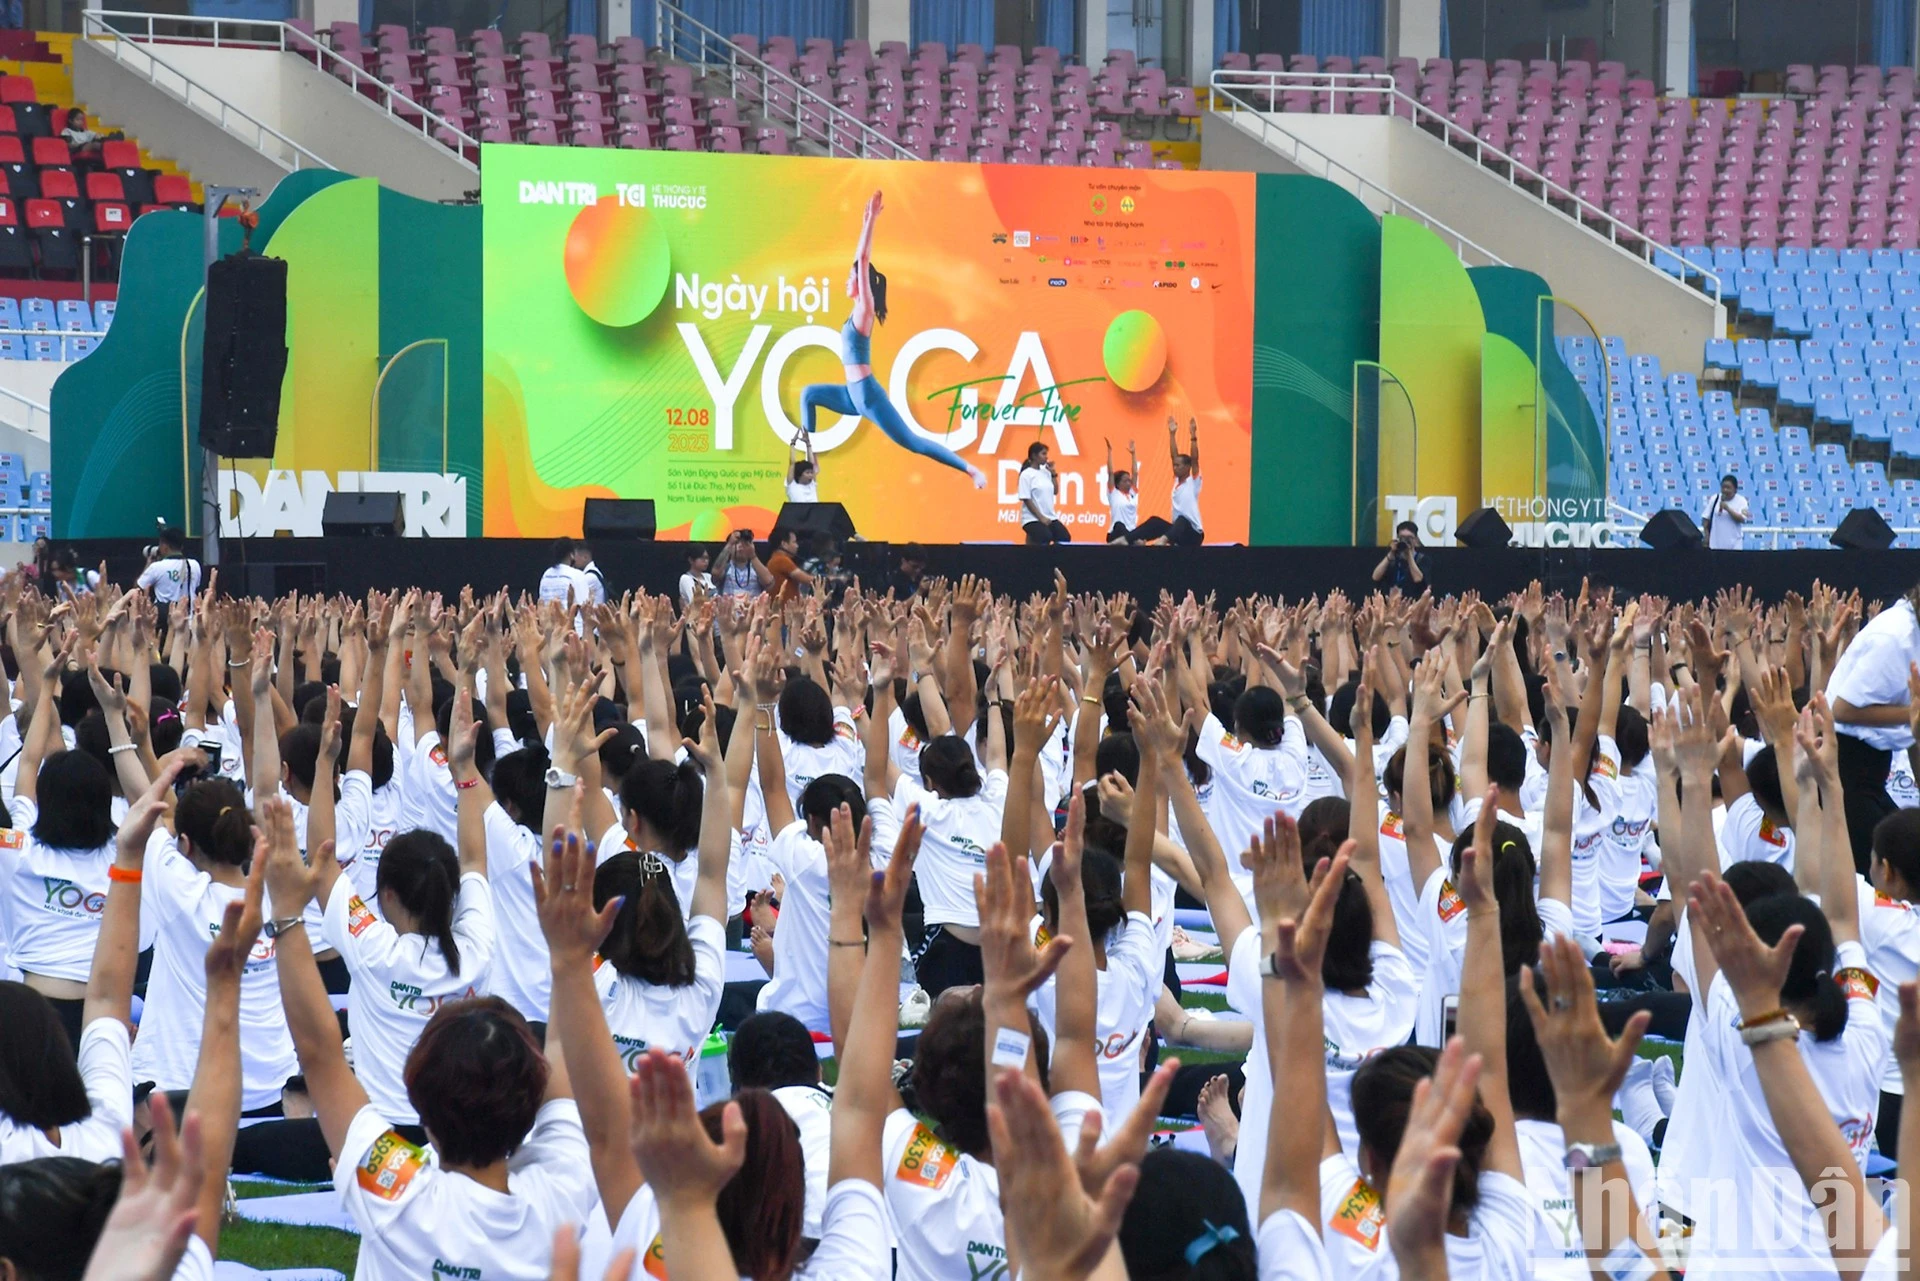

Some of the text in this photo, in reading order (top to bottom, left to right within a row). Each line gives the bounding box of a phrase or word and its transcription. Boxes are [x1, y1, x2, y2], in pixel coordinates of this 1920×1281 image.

[676, 273, 829, 323] Ngày hội
[675, 323, 1079, 456] YOGA
[927, 376, 1106, 443] Forever Fine
[666, 408, 709, 426] 12.08
[668, 434, 709, 452] 2023
[998, 460, 1083, 505] Dn
